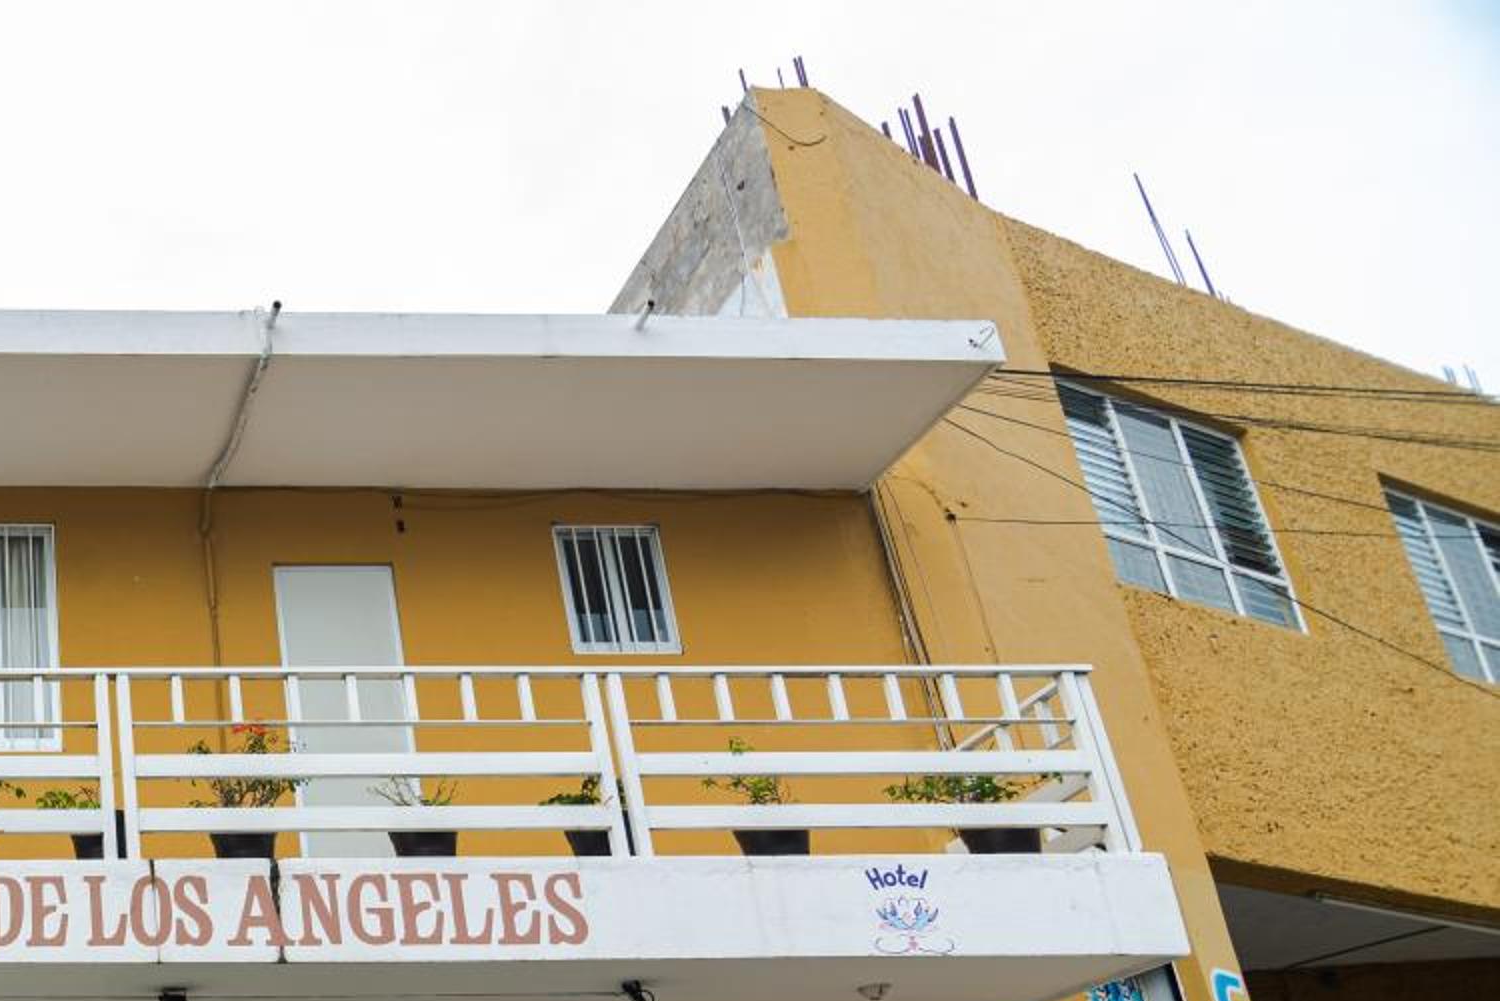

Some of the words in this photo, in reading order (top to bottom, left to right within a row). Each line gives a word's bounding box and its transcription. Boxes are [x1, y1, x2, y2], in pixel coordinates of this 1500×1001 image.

[865, 863, 929, 892] Hotel
[87, 875, 212, 947] LOS
[227, 873, 589, 946] ANGELES
